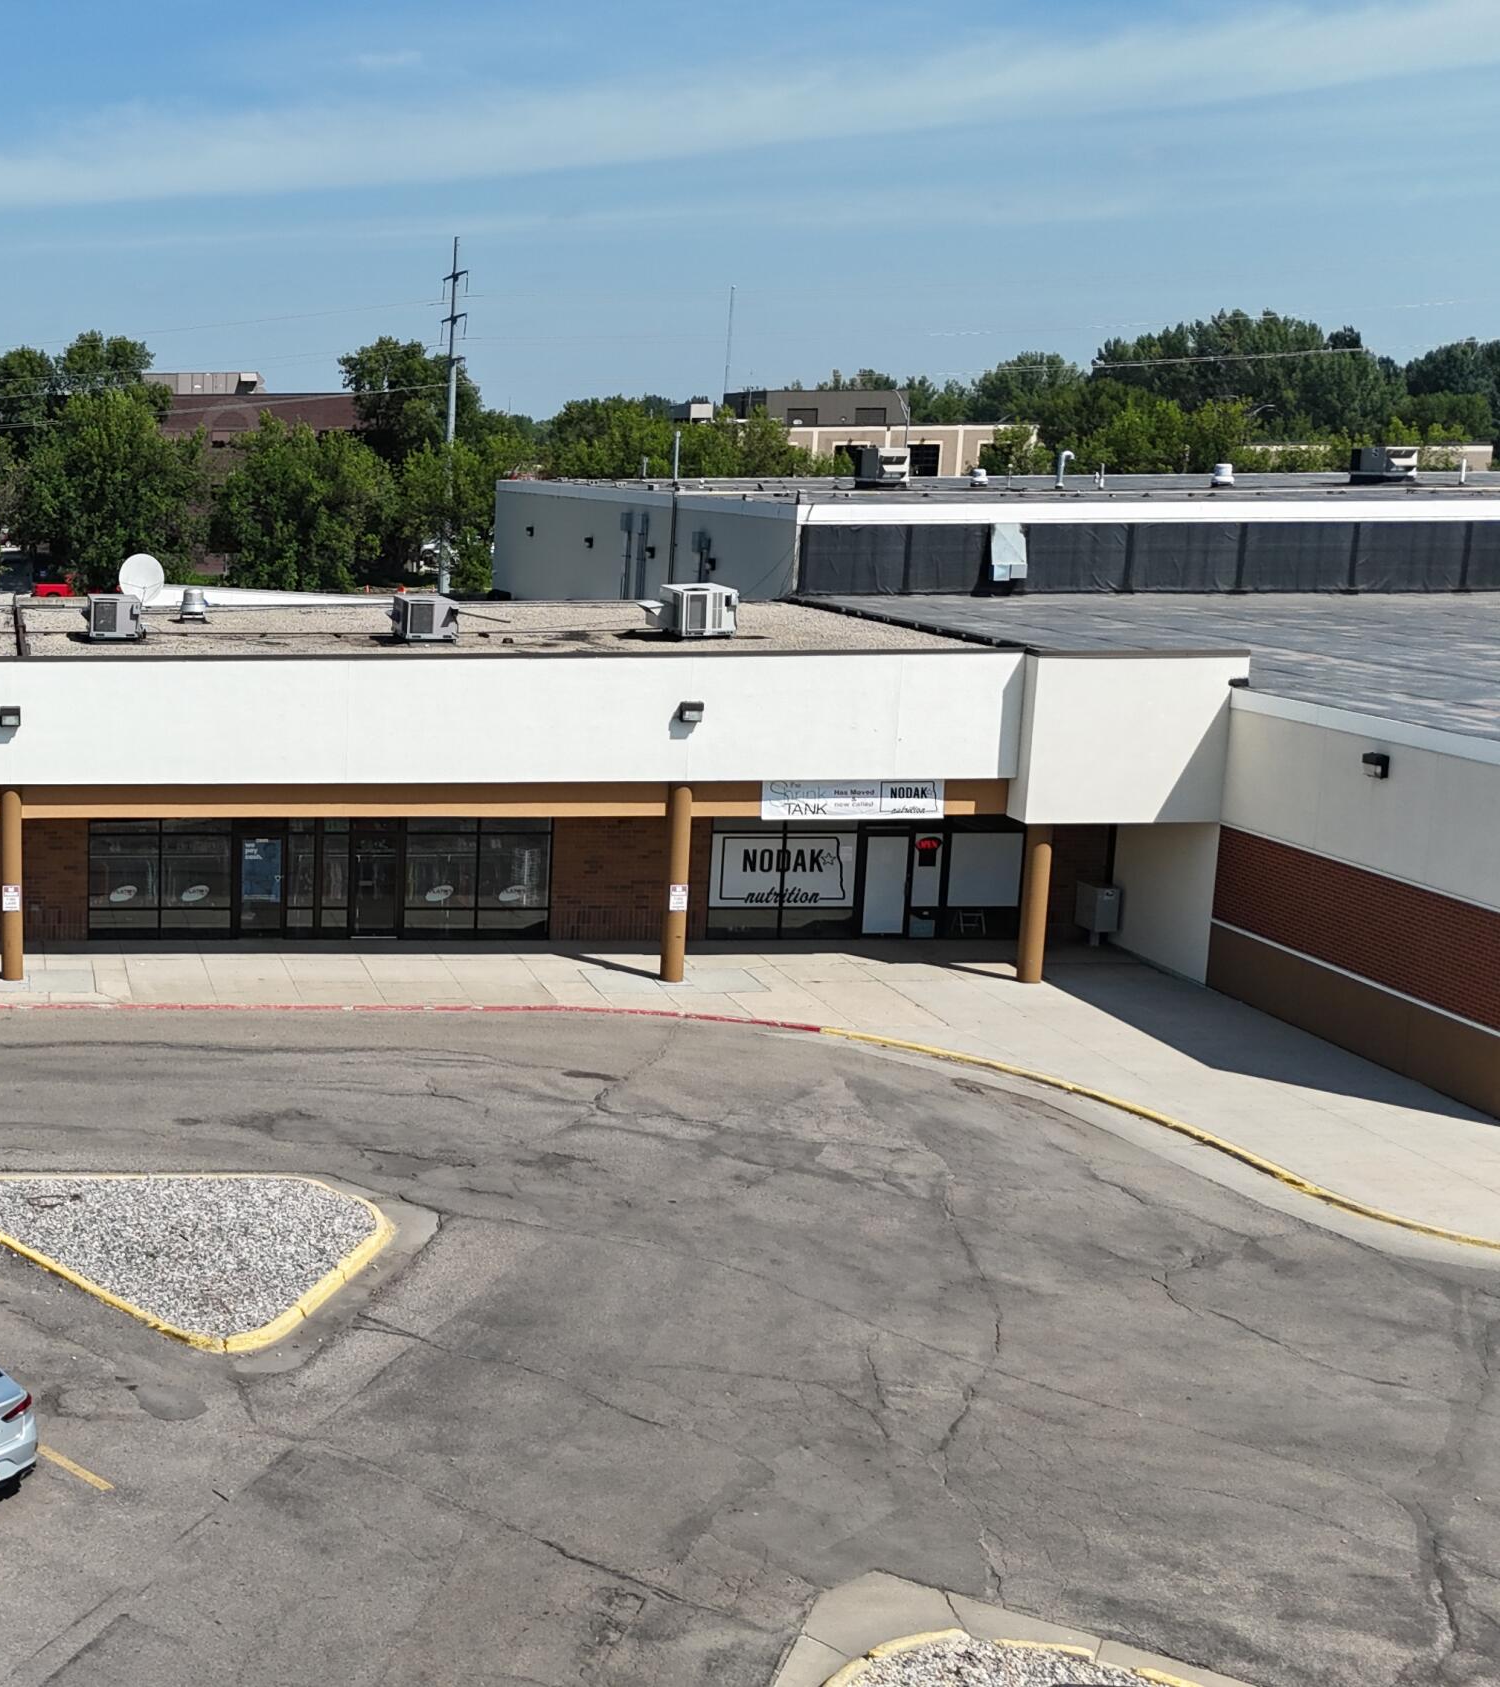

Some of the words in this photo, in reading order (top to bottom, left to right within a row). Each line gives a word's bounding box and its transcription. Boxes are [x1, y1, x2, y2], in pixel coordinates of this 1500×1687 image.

[890, 787, 928, 799] NODAK
[784, 803, 828, 815] TANK
[917, 839, 938, 849] OPEN
[742, 849, 824, 873] NODAK
[744, 886, 820, 904] nutrition
